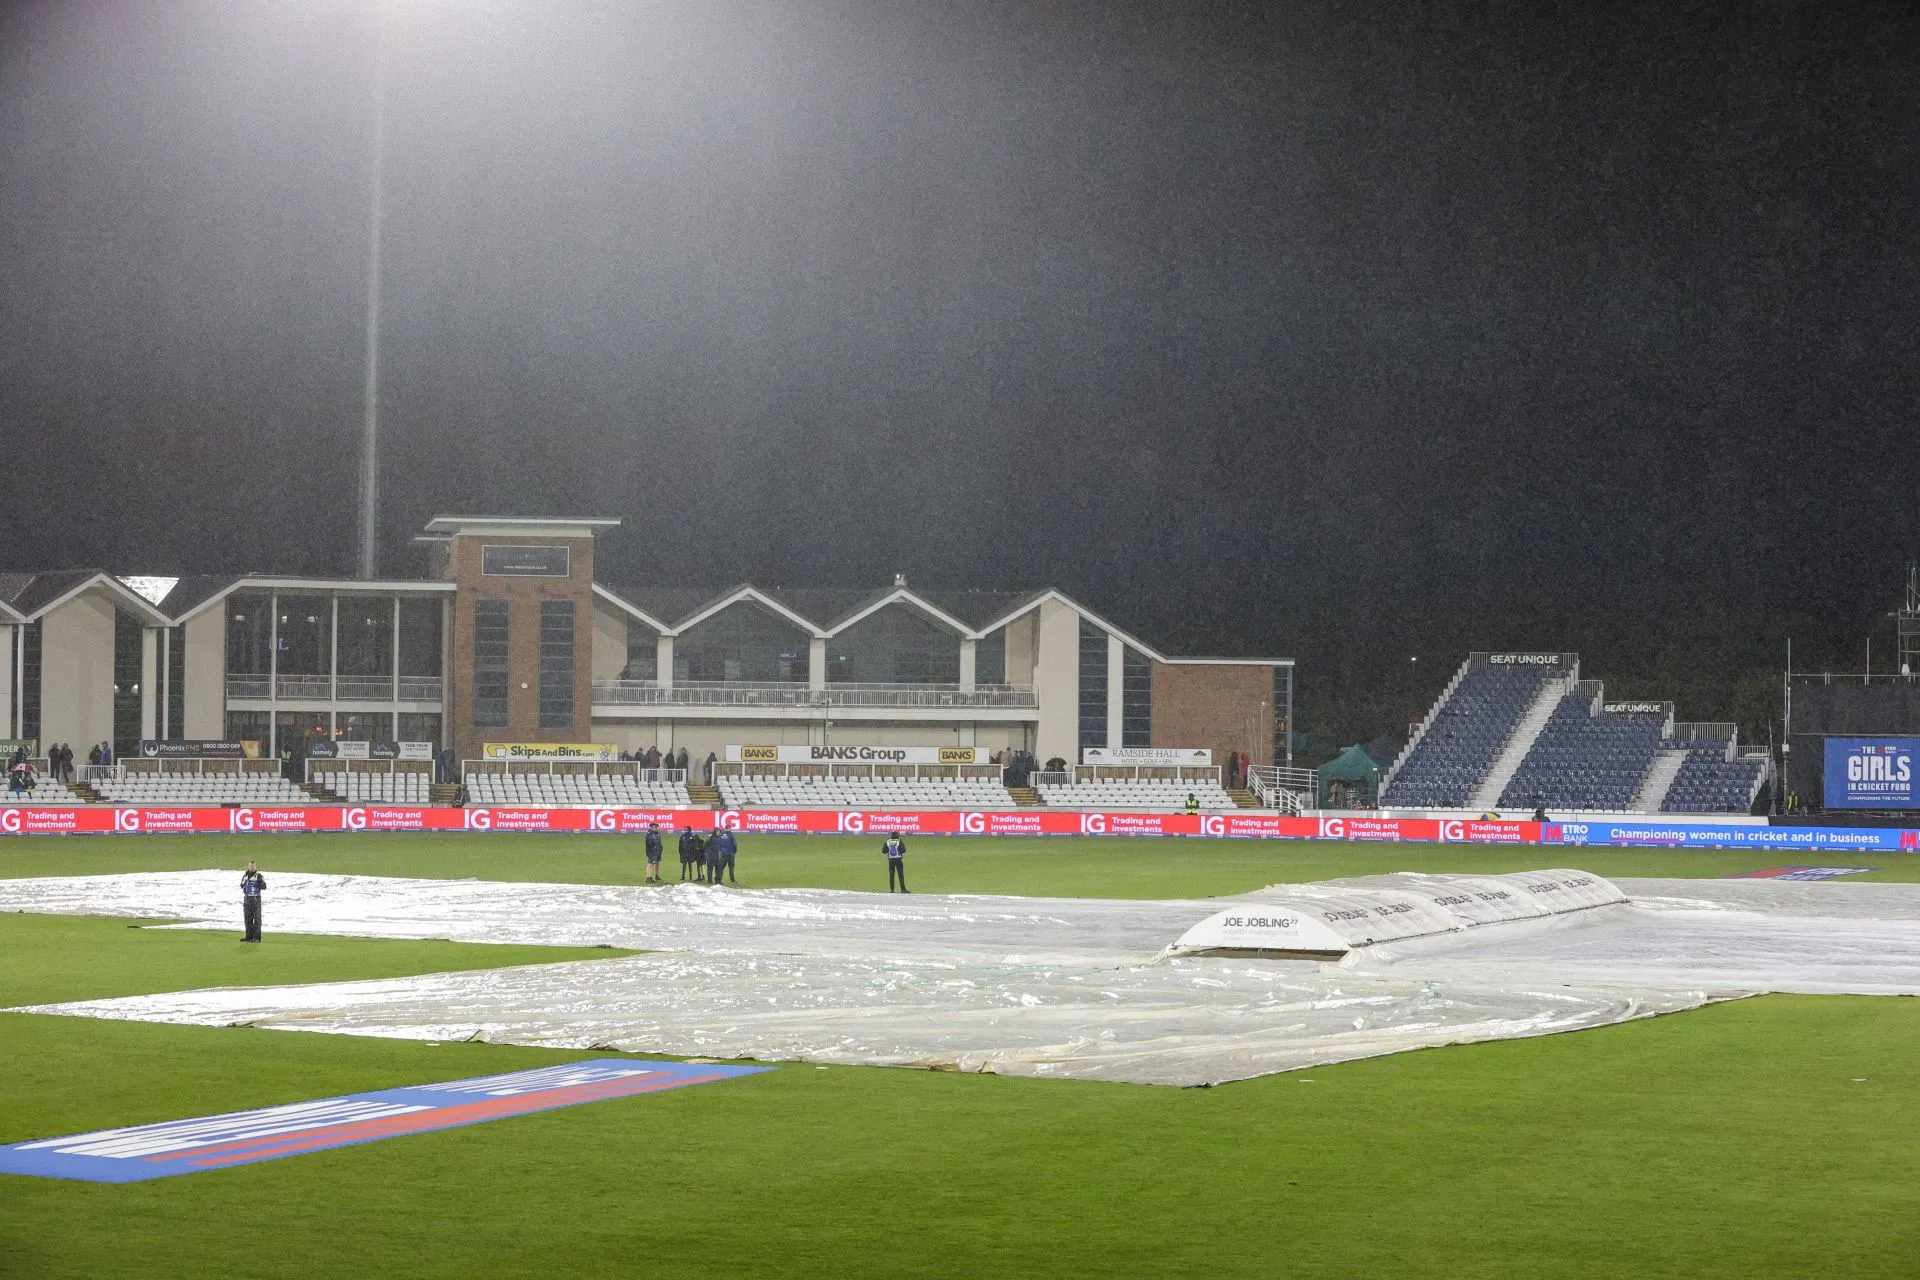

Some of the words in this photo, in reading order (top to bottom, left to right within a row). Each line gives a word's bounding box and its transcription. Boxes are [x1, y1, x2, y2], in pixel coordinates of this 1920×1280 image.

[1490, 655, 1516, 664] SEAT
[1518, 655, 1559, 664] UNIQUE
[1604, 704, 1626, 712] SEAT
[1628, 704, 1661, 713] UNIQUE
[744, 750, 774, 758] BANKS
[811, 746, 857, 759] BANKS
[860, 746, 906, 762] Group
[942, 750, 971, 759] BANKS
[1112, 749, 1153, 757] RAMSIDE
[1848, 755, 1911, 781] GIRLS
[1848, 783, 1856, 791] IN
[1858, 783, 1889, 791] CRICKET
[1891, 783, 1911, 791] FUND
[27, 812, 57, 820] Trading
[145, 812, 175, 820] Trading
[230, 809, 253, 829] IG
[259, 811, 288, 820] Trading
[342, 809, 366, 829] IG
[372, 811, 403, 819] Trading
[464, 809, 490, 829] IG
[497, 812, 530, 820] Trading
[590, 810, 616, 829] IG
[622, 812, 655, 821] Trading
[747, 814, 779, 822] Trading
[870, 815, 901, 823] Trading
[991, 815, 1022, 824] Trading
[0, 809, 21, 831] G
[27, 820, 76, 829] investments
[115, 809, 139, 831] IG
[145, 820, 193, 828] investments
[372, 819, 422, 827] investments
[497, 820, 549, 828] investments
[714, 811, 740, 830] IG
[838, 812, 863, 831] IG
[959, 813, 984, 832] IG
[1081, 814, 1105, 832] IG
[1112, 817, 1143, 825] Trading
[1231, 819, 1262, 827] Trading
[747, 822, 797, 830] investments
[1200, 816, 1224, 834] IG
[1319, 818, 1343, 837] IG
[1350, 821, 1381, 830] Trading
[1470, 823, 1502, 832] Trading
[1439, 821, 1463, 840] IG
[1470, 832, 1520, 840] investments
[1611, 829, 1686, 841] Championing
[1689, 831, 1731, 840] women
[1734, 831, 1744, 840] in
[1748, 831, 1787, 841] cricket
[1791, 832, 1811, 842] and
[1816, 832, 1826, 842] in
[1830, 832, 1880, 843] business
[1223, 918, 1243, 926] JOE
[1245, 918, 1289, 927] JOBLING
